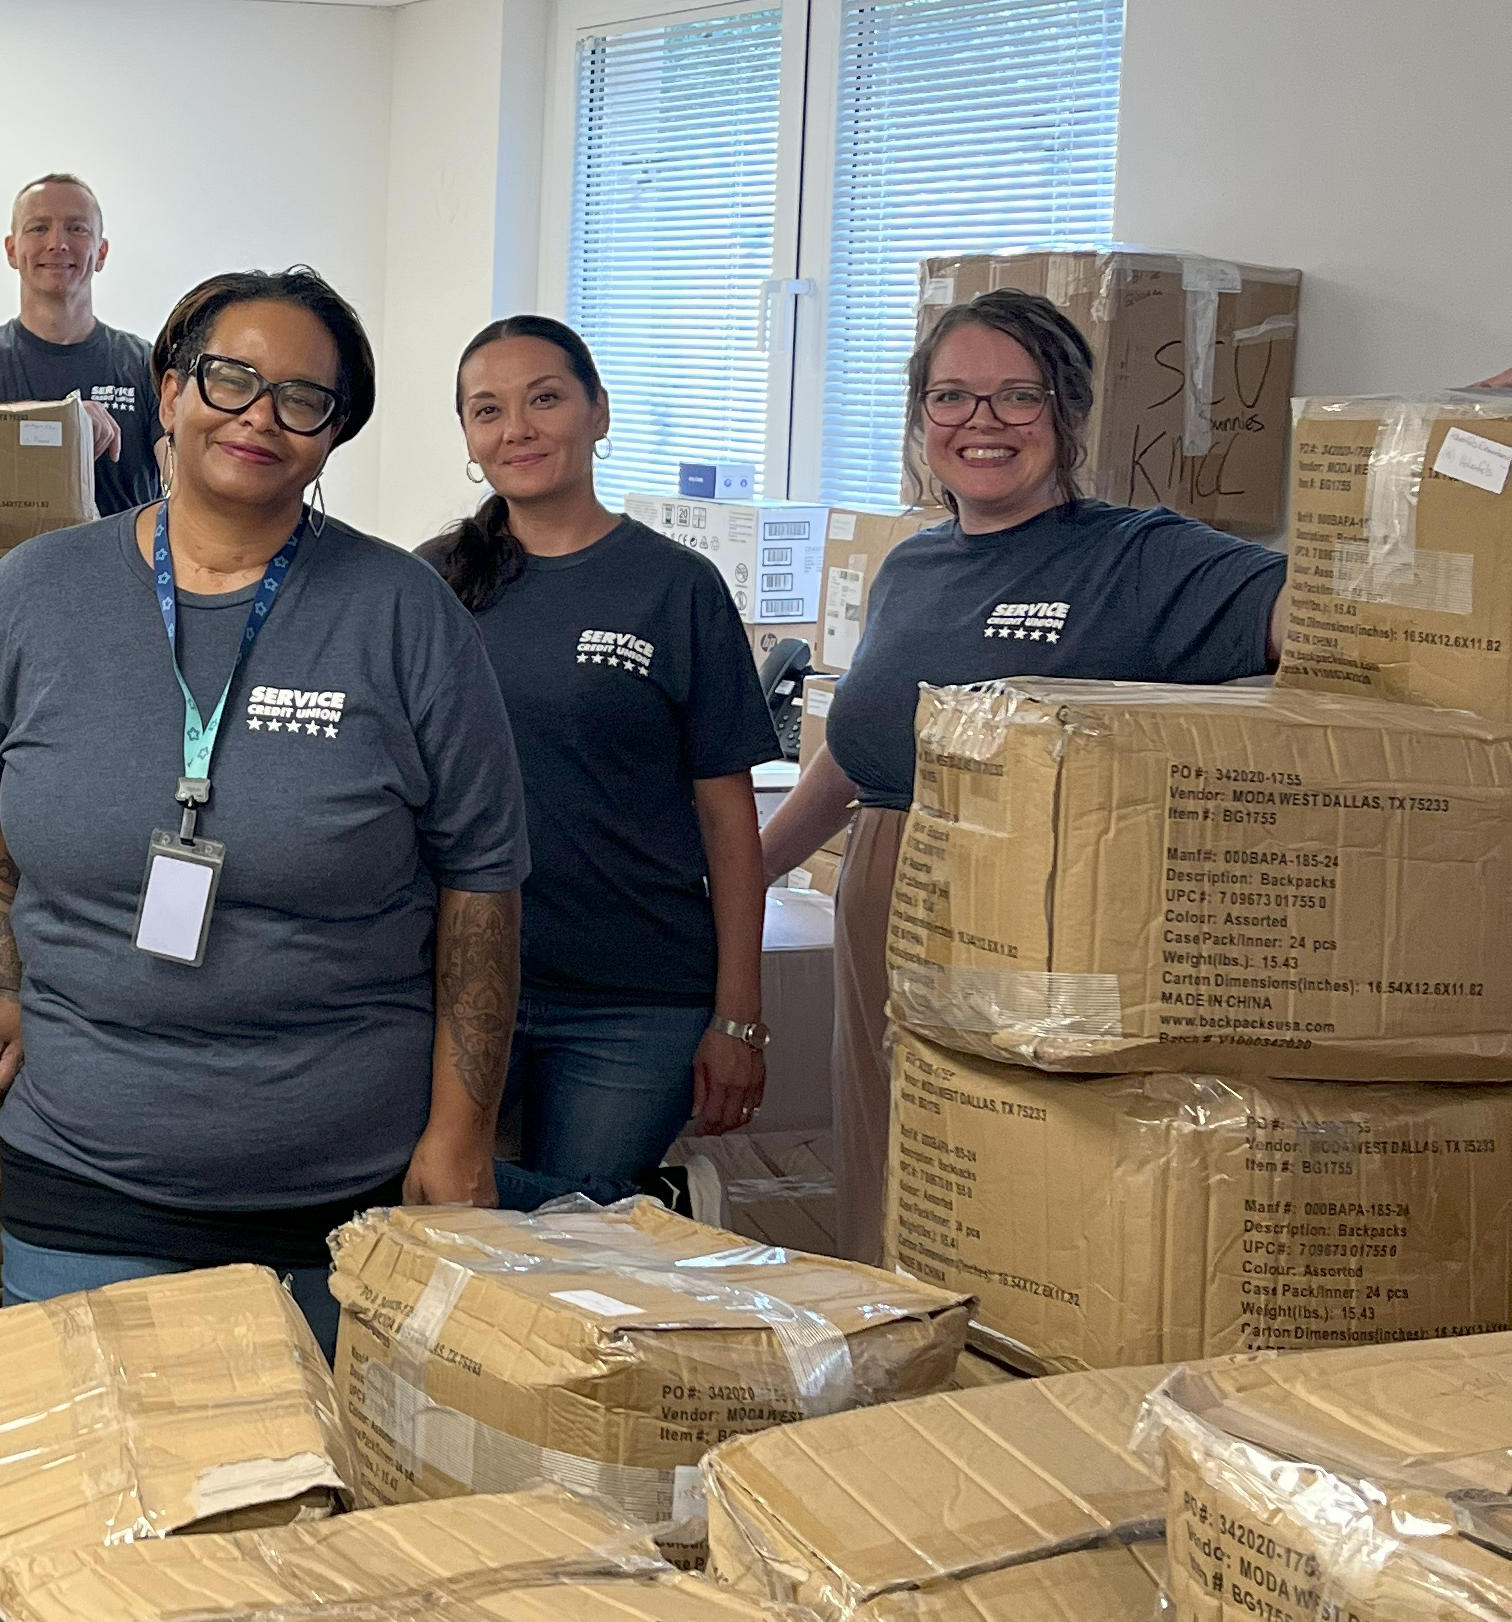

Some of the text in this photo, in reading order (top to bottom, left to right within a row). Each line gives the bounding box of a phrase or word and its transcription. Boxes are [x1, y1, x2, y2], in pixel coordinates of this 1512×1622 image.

[91, 385, 135, 397] SERVICE
[990, 602, 1071, 619] SERVICE
[986, 617, 1065, 630] CREDIT UNION
[578, 628, 655, 658] SERVICE
[615, 645, 651, 668] UNION
[248, 685, 346, 710] SERVICE
[247, 703, 342, 723] CREDIT UNION
[1170, 764, 1189, 779] PO
[1216, 767, 1302, 786] 342020-1755
[1169, 785, 1450, 812] Vendor: MODA WEST DALLAS, TX 75233
[1168, 807, 1199, 822] Item
[1223, 809, 1277, 826] BG1755
[1167, 868, 1337, 891] Description: Backpacks
[1164, 908, 1288, 929] Colour: Assorted
[1289, 935, 1307, 950] 24
[1312, 936, 1337, 953] pcs
[1162, 951, 1299, 971] Weight(lbs.): 15.43
[1162, 970, 1211, 988] Carton
[1213, 973, 1361, 997] Dimensions(inches):
[1160, 991, 1273, 1011] MADE IN CHINA
[1159, 1011, 1336, 1034] www.backpacksusa.com
[1444, 1139, 1460, 1152] TX
[1245, 1158, 1278, 1172] Item
[1301, 1160, 1353, 1176] BG1755
[1244, 1199, 1280, 1214] Manf
[1244, 1219, 1408, 1240] Description: Backpacks
[1242, 1260, 1364, 1279] Colour: Assorted
[1241, 1281, 1410, 1303] Case Pack/Inner: 24 pcs
[1241, 1301, 1375, 1322] Weight(lbs.): 15.43
[1241, 1322, 1290, 1339] Carton
[661, 1384, 685, 1400] PO
[660, 1406, 721, 1422] Vendor:
[726, 1406, 764, 1422] MODA
[660, 1426, 694, 1442] Item
[1239, 1556, 1289, 1602] MODA
